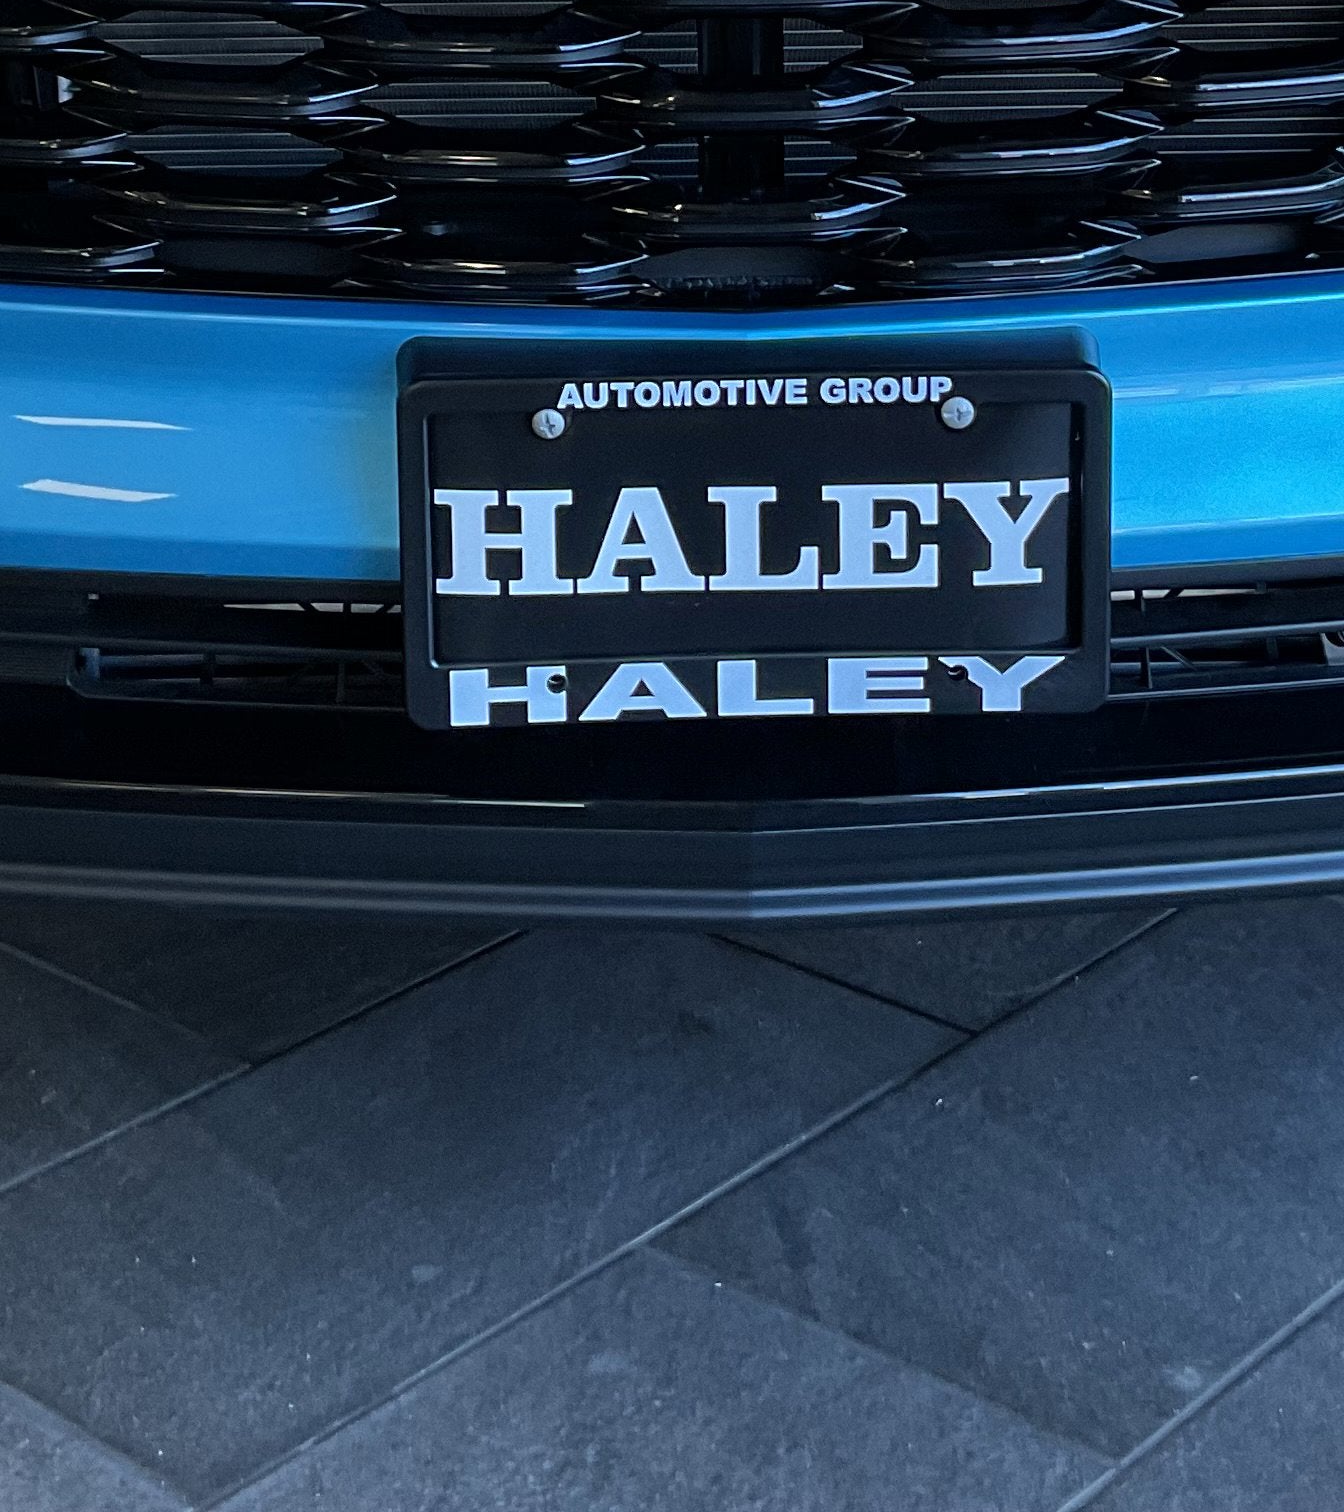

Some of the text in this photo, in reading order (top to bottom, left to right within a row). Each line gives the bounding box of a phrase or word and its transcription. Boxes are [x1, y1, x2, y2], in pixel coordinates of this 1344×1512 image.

[557, 375, 953, 410] AUTOMOTIVE GROUP
[433, 477, 1070, 596] HALEY
[448, 655, 1066, 728] HALEY
